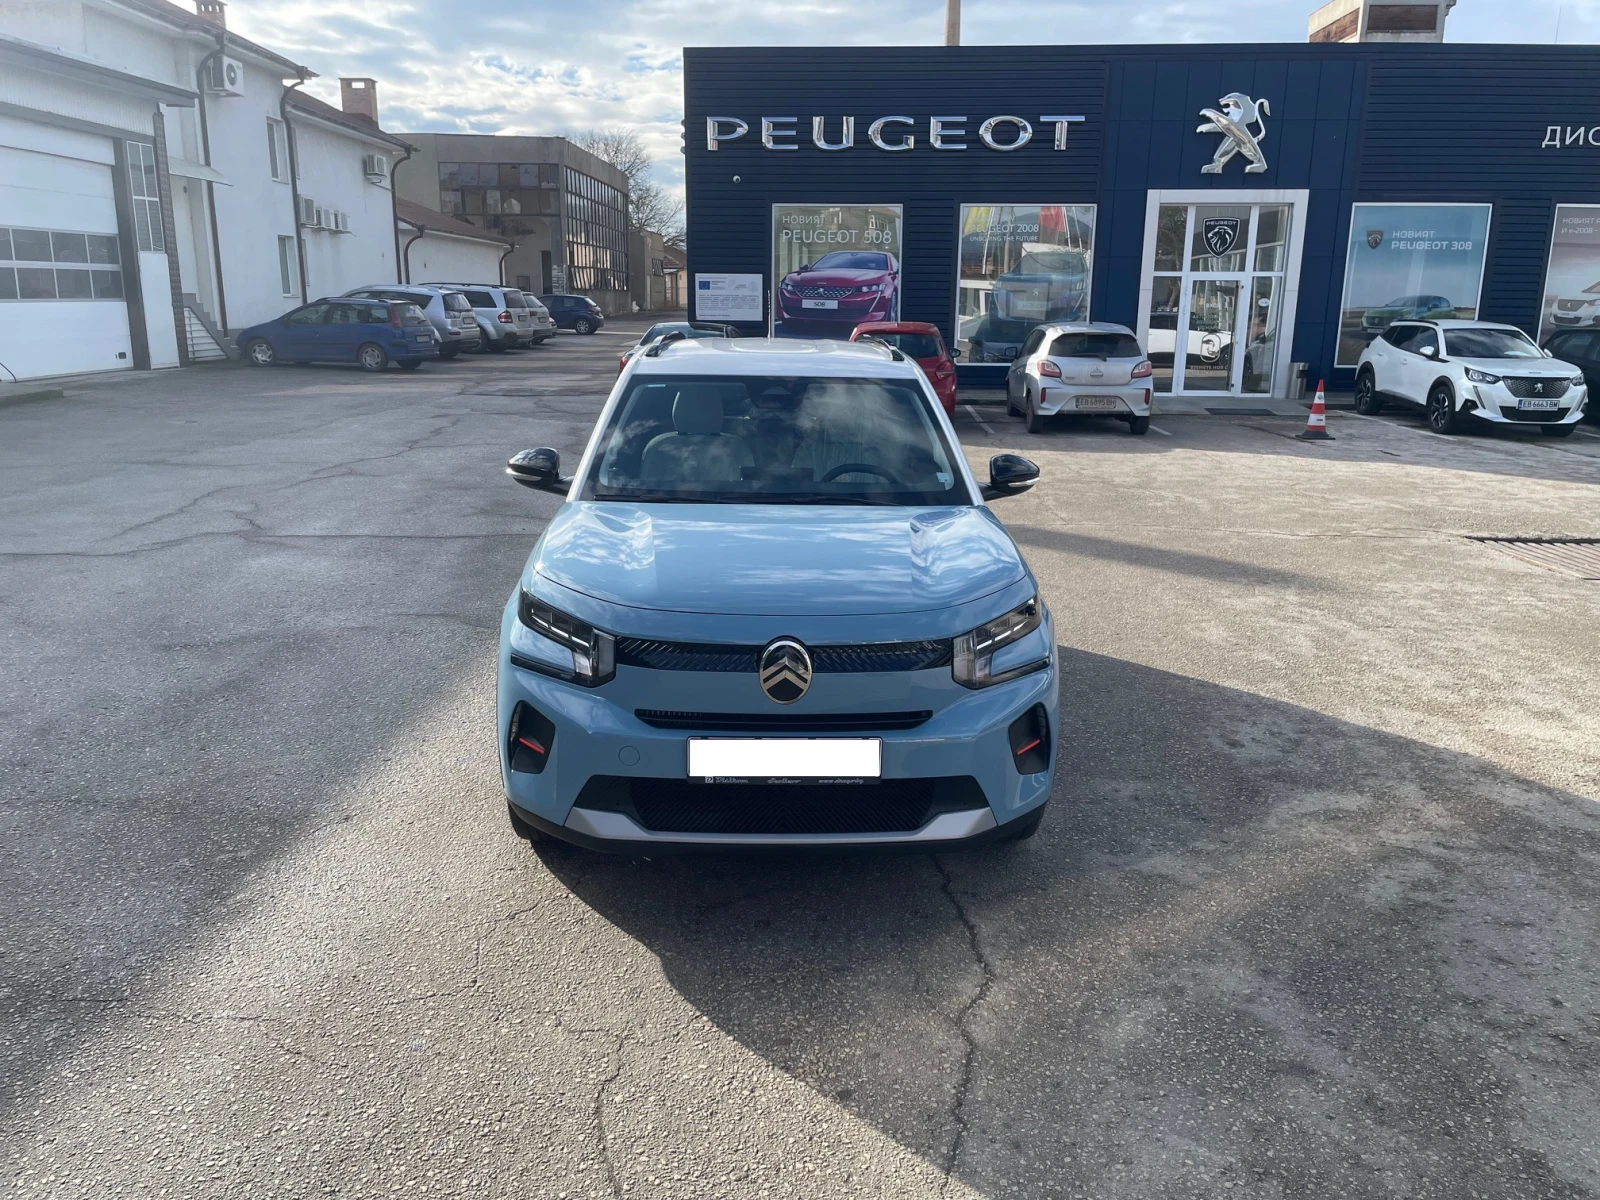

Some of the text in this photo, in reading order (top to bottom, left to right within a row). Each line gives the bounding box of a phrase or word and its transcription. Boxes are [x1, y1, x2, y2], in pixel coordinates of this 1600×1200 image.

[706, 115, 1085, 152] PEUGEOT
[782, 215, 825, 224] НОВИЯТ
[970, 224, 1039, 233] PEUGEOT 2008
[782, 229, 892, 244] PEUGEOT 508
[1392, 230, 1436, 239] НОВИЯТ
[1391, 240, 1473, 250] PEUGEOT 308
[1080, 398, 1089, 406] EB
